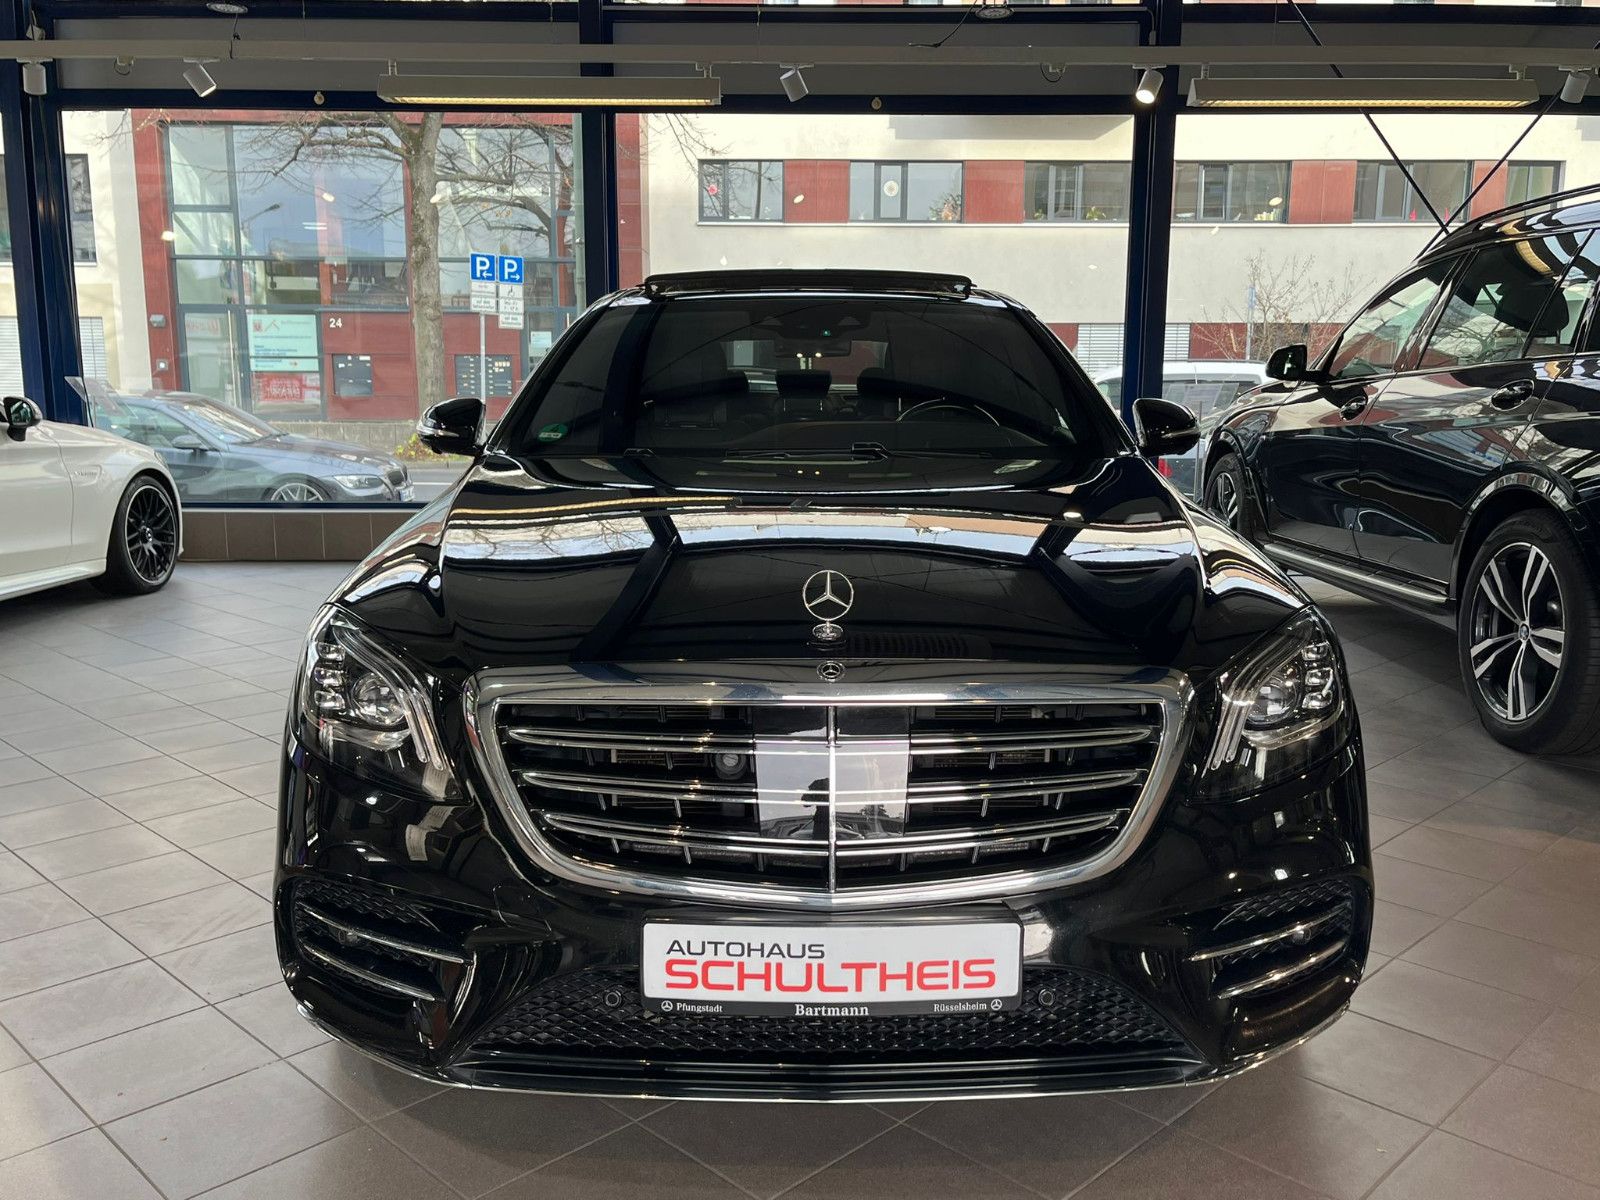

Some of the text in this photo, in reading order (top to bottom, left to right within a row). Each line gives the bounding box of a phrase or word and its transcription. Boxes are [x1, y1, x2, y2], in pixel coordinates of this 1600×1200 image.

[476, 257, 490, 278] P
[504, 259, 518, 280] P
[329, 318, 343, 328] 24
[667, 940, 825, 959] AUTOHAUS
[664, 958, 996, 993] SCHULTHEIS
[676, 1002, 723, 1014] Pfungstadt
[794, 1003, 869, 1017] Bartmann
[933, 1001, 987, 1013] Rüsselsheim
